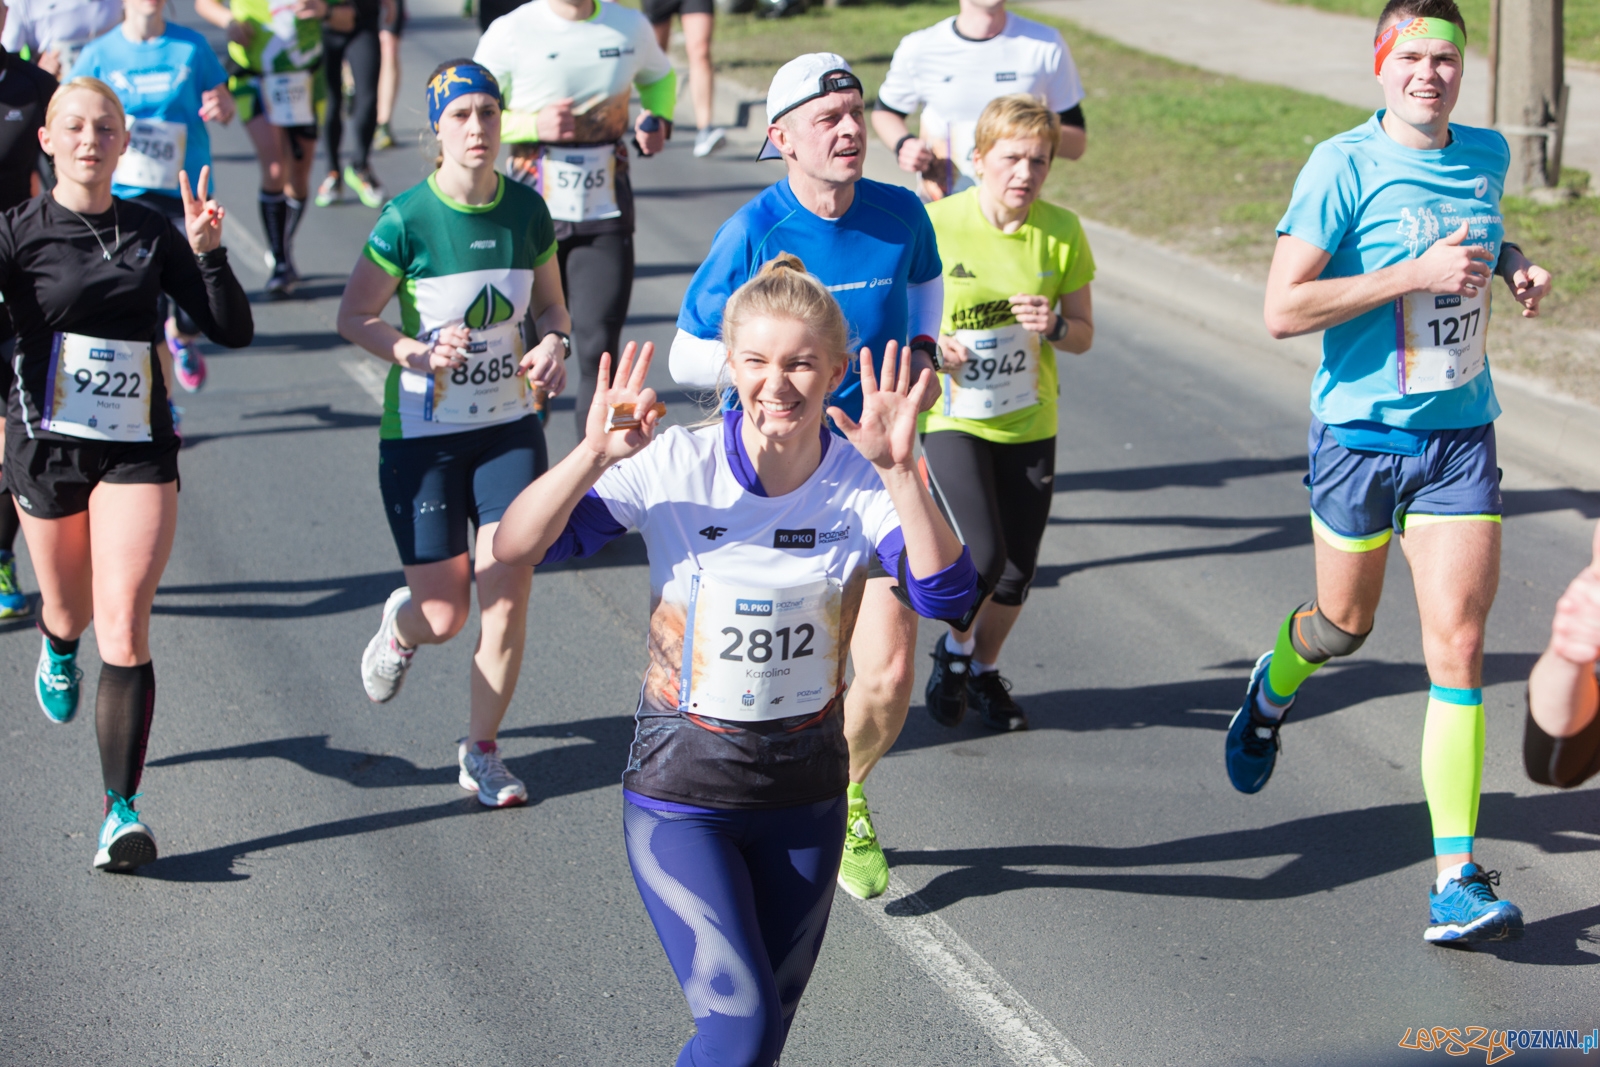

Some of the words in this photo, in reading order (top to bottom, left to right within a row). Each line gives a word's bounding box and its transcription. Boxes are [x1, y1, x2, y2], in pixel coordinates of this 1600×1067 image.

[558, 169, 605, 190] 5765
[1440, 203, 1456, 213] 25.
[1447, 296, 1460, 304] PKO
[1427, 307, 1481, 347] 1277
[451, 353, 514, 386] 8685
[964, 349, 1026, 382] 3942
[73, 368, 142, 399] 9222
[97, 400, 121, 410] Marta
[699, 525, 728, 541] 4F
[778, 534, 790, 543] 10.
[791, 534, 813, 543] PKO
[738, 603, 750, 612] 10.
[751, 604, 770, 612] PKO
[719, 622, 815, 664] 2812
[745, 667, 791, 679] Karolina
